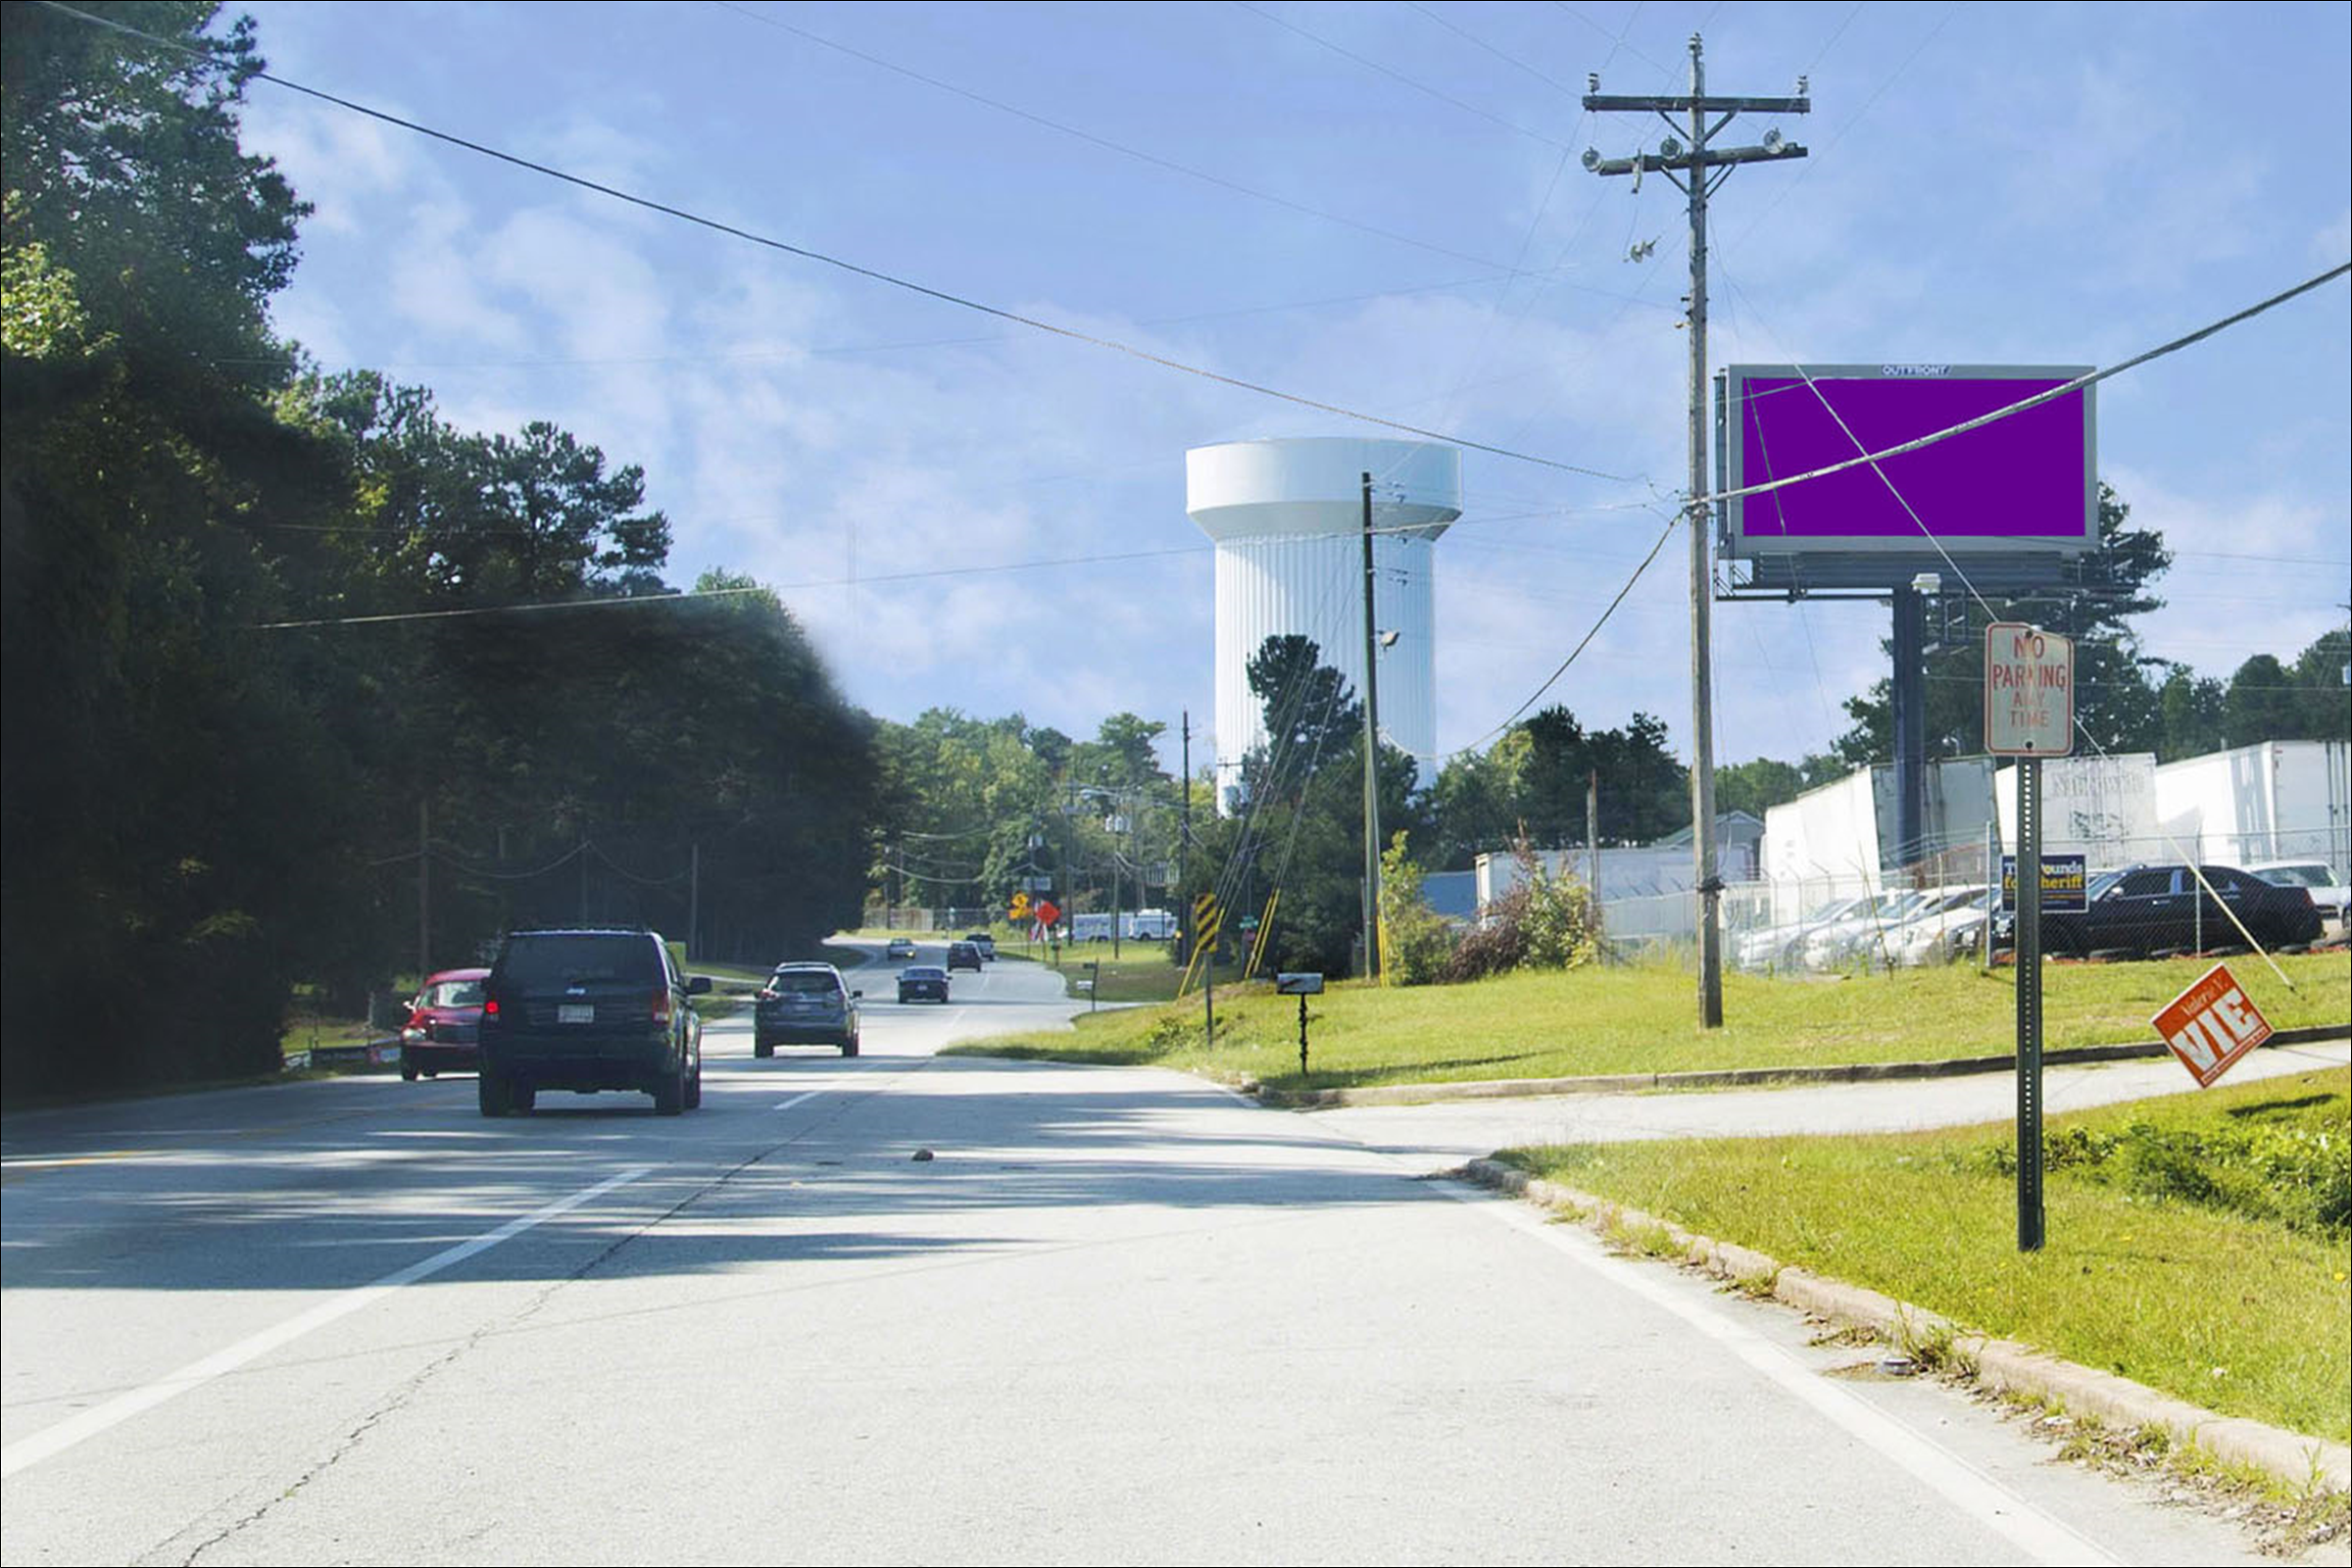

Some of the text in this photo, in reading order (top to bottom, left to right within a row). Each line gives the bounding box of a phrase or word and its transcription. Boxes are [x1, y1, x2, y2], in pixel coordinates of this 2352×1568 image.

[2014, 635, 2044, 659] NO
[2011, 710, 2049, 727] TIME
[2040, 860, 2082, 875] ounds
[2040, 875, 2082, 890] heriff
[2170, 988, 2262, 1072] VIE
